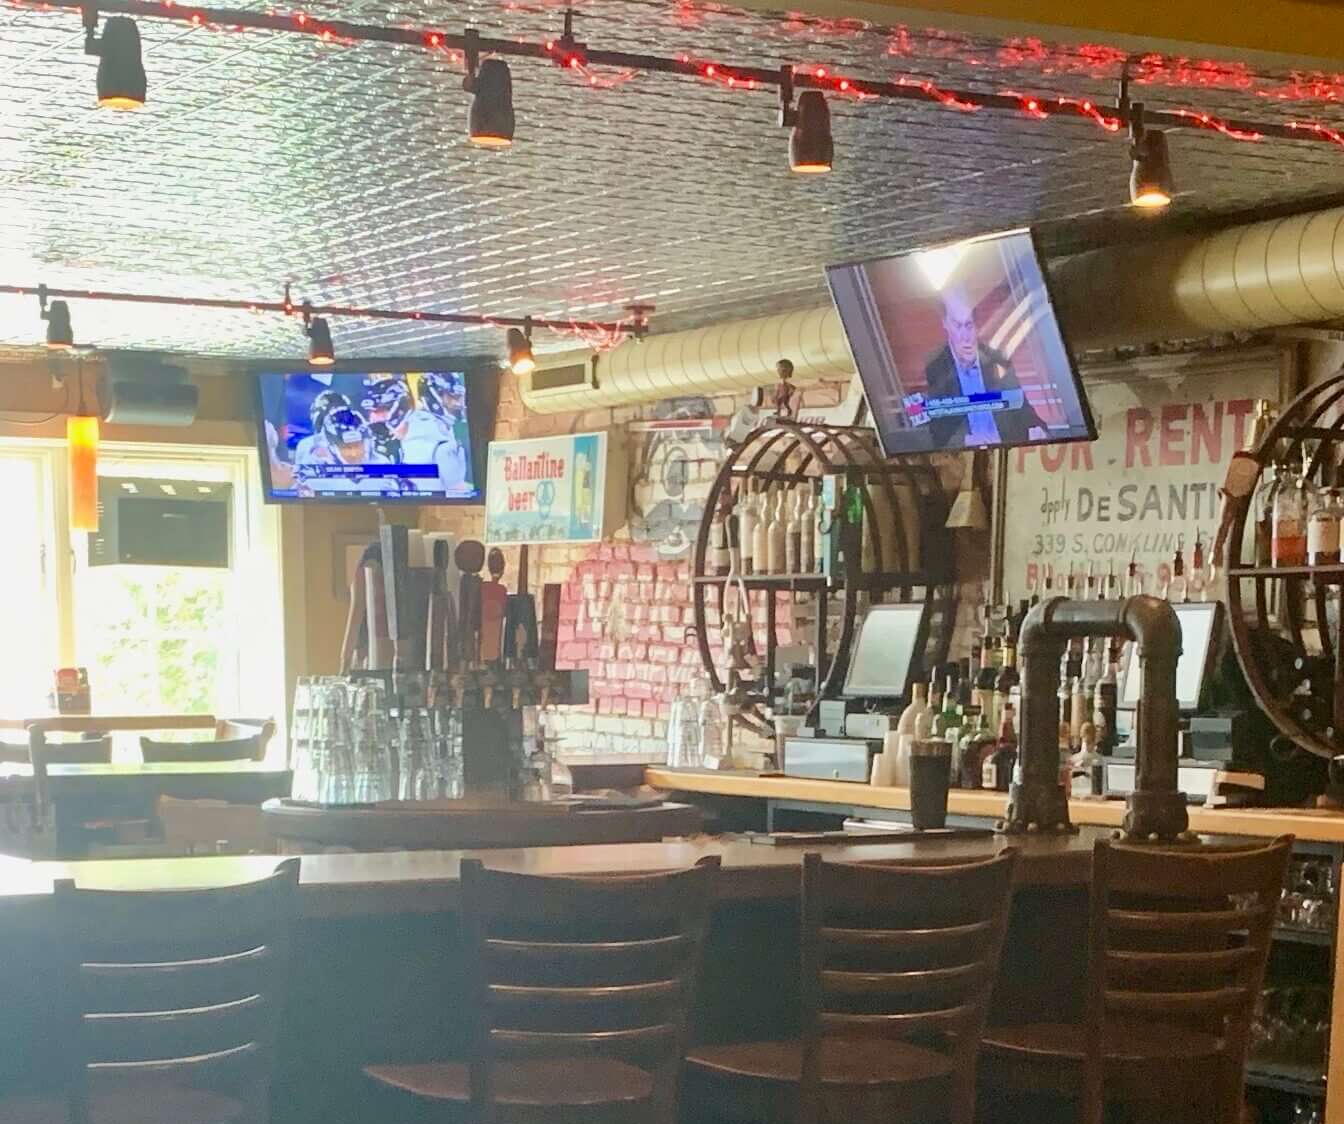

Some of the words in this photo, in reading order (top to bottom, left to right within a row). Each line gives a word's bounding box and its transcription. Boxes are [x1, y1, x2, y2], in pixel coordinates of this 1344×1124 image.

[1124, 399, 1254, 469] RENT
[508, 486, 536, 512] beer
[1032, 533, 1066, 555] 339
